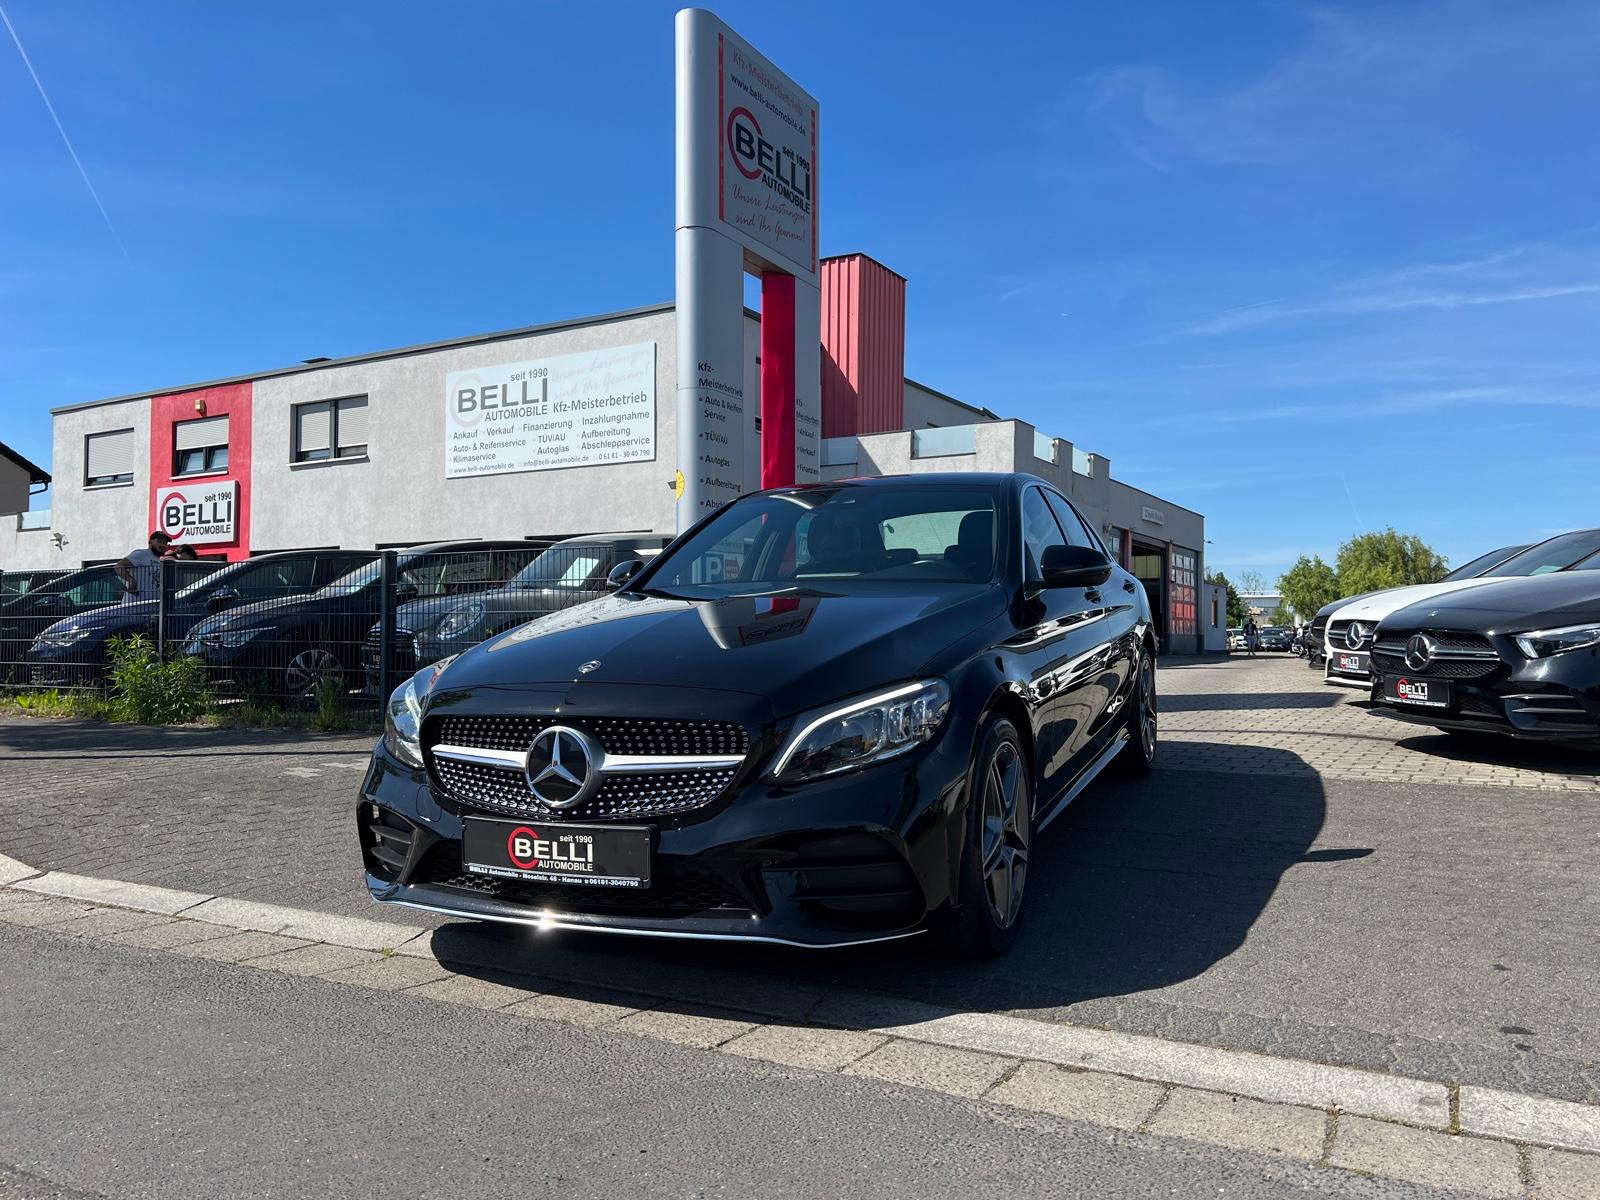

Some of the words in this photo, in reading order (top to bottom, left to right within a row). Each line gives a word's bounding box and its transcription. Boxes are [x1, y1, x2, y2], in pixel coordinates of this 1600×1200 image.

[733, 50, 804, 115] Kfz-Meisterbetrieb
[730, 73, 806, 136] www.belli-automobile.de
[736, 122, 810, 200] BELLI
[782, 146, 794, 161] seit
[796, 154, 810, 172] 1990
[732, 184, 761, 207] Unsere
[761, 173, 810, 215] AUTOMOBILE
[510, 371, 526, 382] seit
[529, 367, 548, 378] 1990
[698, 363, 714, 374] Kfz-
[458, 378, 548, 413] BELLI
[698, 377, 743, 398] Meisterbetrieb
[553, 391, 648, 414] Kfz-Meisterbetrieb
[704, 396, 722, 408] Auto
[726, 401, 743, 413] Reifen
[485, 405, 548, 422] AUTOMOBILE
[704, 409, 726, 422] Service
[453, 430, 478, 440] Ankauf
[487, 425, 514, 436] Verkauf
[523, 419, 573, 433] Finanzierung
[582, 410, 650, 426] Inzahlungnahme
[581, 427, 631, 440] Aufbereitung
[453, 444, 471, 453] Auto-
[472, 443, 478, 451] &
[479, 437, 526, 450] Reifenservice
[537, 444, 570, 455] Autoglas
[581, 436, 650, 451] Abschleppservice
[453, 452, 496, 463] Klimaservice
[453, 462, 515, 473] www.belli-automobile.de
[523, 455, 589, 467] info@belli-automobile.de
[705, 454, 730, 468] Autoglas
[705, 477, 741, 493] Aufbereitung
[205, 493, 216, 502] seit
[217, 491, 232, 501] 1990
[166, 501, 232, 527] BELLI
[185, 524, 231, 536] AUTOMOBILE
[1341, 657, 1359, 666] BELLI
[1399, 683, 1428, 697] BELLI
[559, 835, 574, 843] seit
[575, 835, 593, 844] 1990
[514, 838, 593, 863] BELLI
[469, 866, 488, 874] BELLI
[488, 868, 519, 878] Automobile
[522, 873, 549, 882] Moselstr.
[537, 861, 593, 872] AUTOMOBILE
